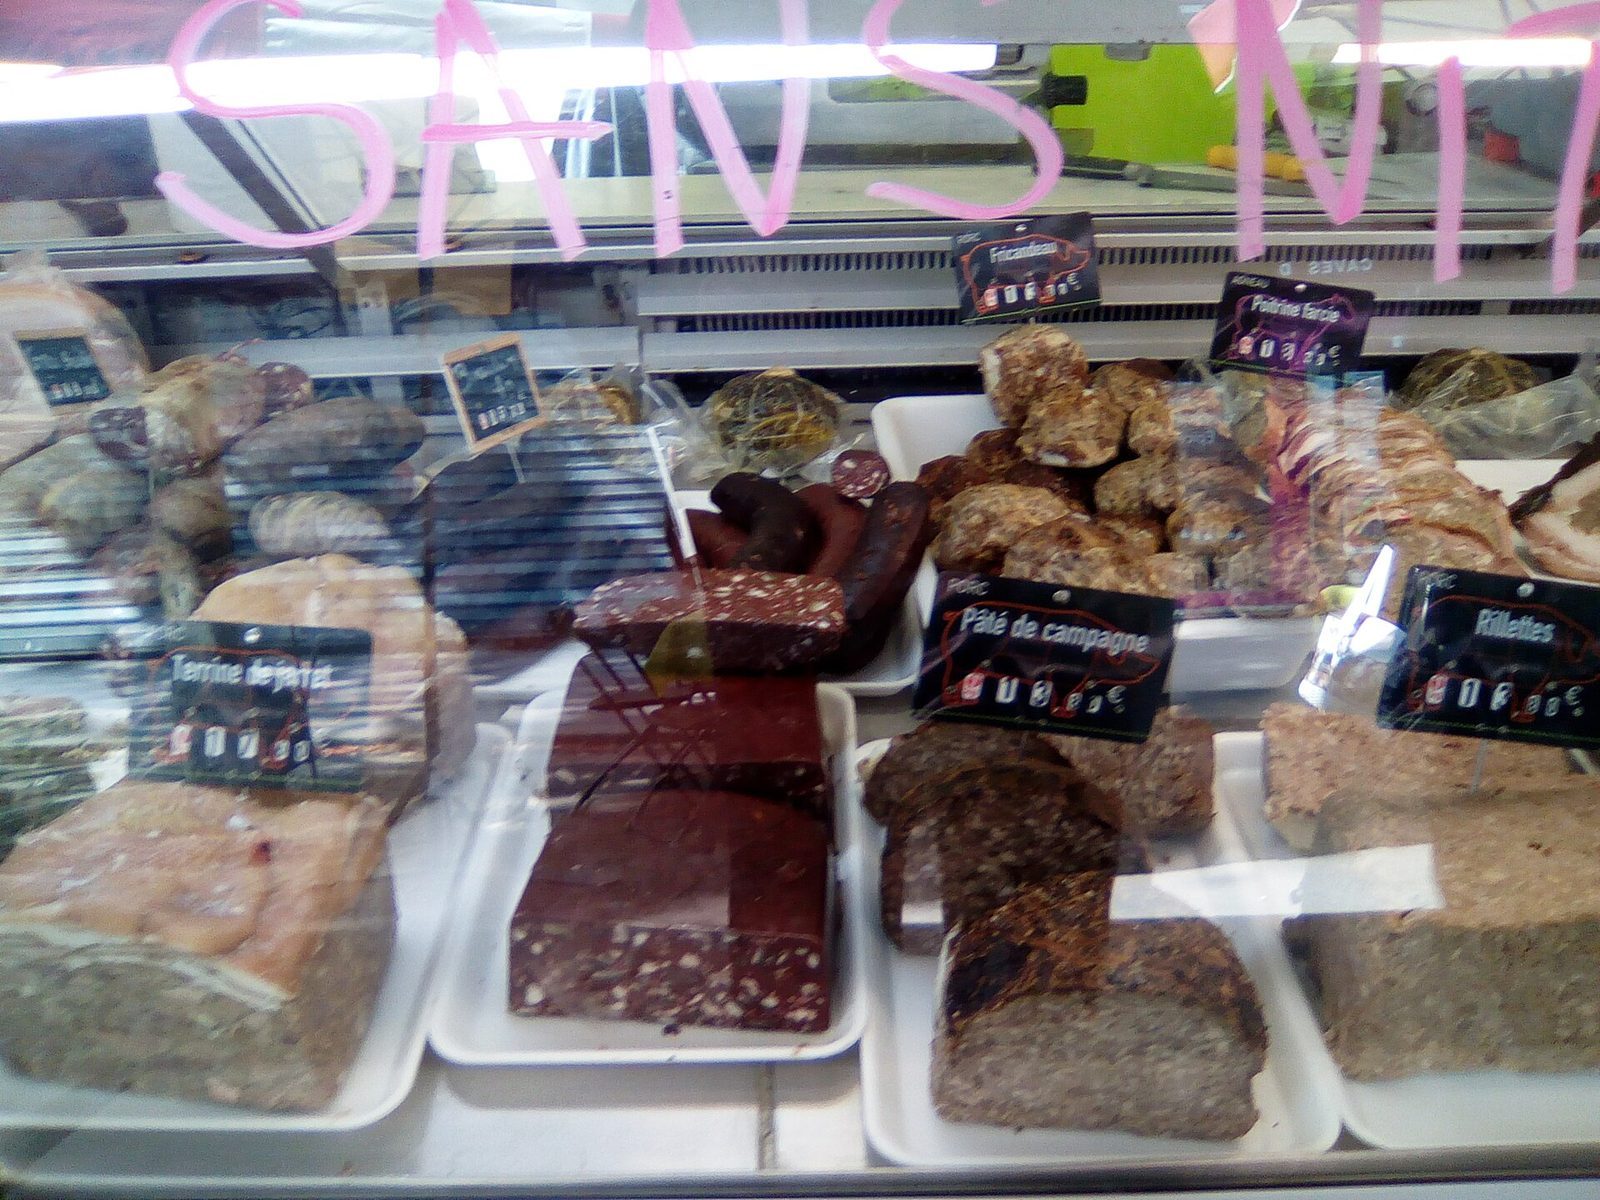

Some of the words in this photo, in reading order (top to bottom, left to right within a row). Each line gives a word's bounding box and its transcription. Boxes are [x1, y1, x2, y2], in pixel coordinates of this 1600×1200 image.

[155, 0, 1065, 260] SANS
[960, 607, 1008, 635] Pâté
[1010, 613, 1039, 639] de
[1042, 622, 1150, 656] campagne
[1474, 607, 1555, 643] Rillettes
[171, 653, 244, 685] Terrine
